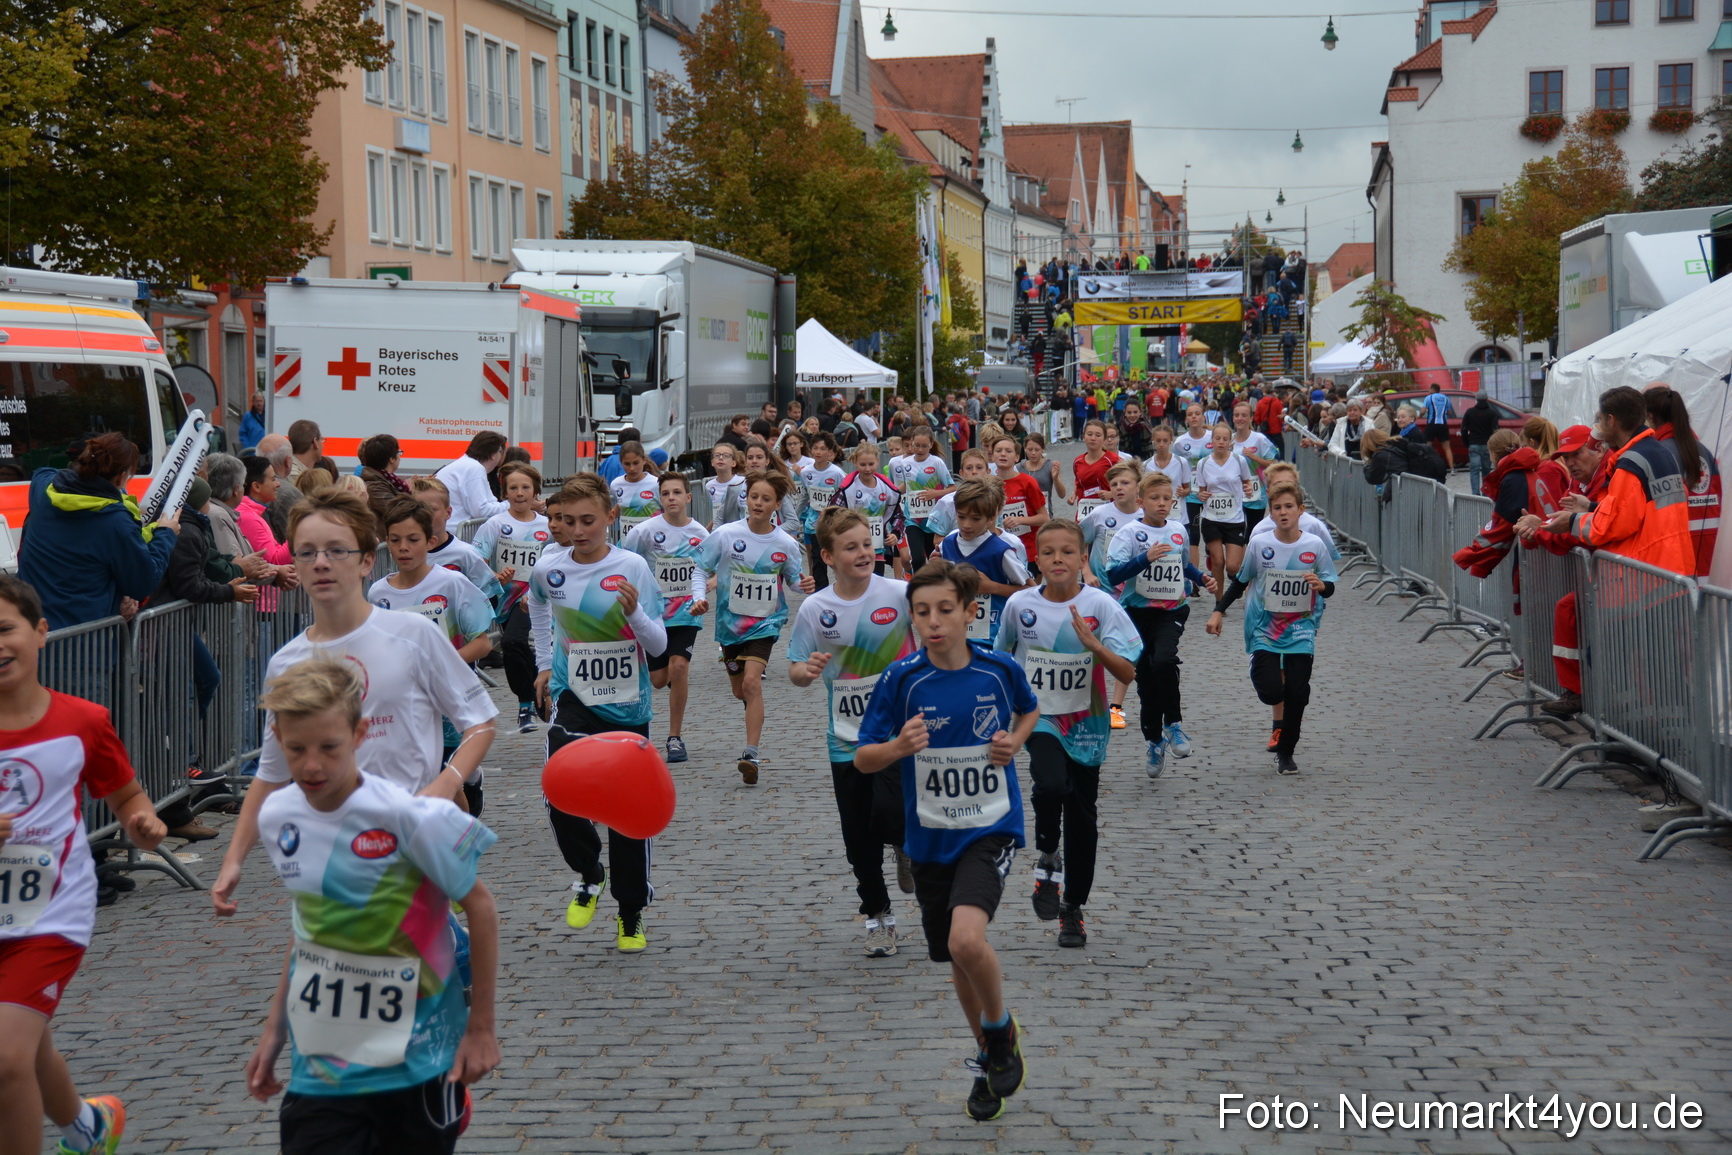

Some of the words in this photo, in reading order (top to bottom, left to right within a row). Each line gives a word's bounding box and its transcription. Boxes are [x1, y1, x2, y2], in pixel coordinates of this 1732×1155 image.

[1128, 305, 1186, 320] START
[477, 335, 505, 343] 44/54/1
[747, 315, 768, 354] BOCK
[378, 348, 459, 362] Bayerisches
[378, 364, 416, 376] Rotes
[801, 374, 853, 385] Laufsport
[377, 381, 417, 393] Kreuz
[418, 417, 503, 428] Katastrophenschutz
[426, 427, 463, 436] Freistaat
[1209, 500, 1233, 510] 4034
[500, 549, 537, 567] 4116
[660, 566, 695, 582] 4008
[1142, 565, 1181, 582] 4042
[734, 583, 773, 601] 4111
[1270, 580, 1309, 597] 4000
[873, 611, 895, 622] Hervis
[570, 648, 593, 656] PARTL
[593, 647, 627, 655] Neumarkt
[1027, 656, 1047, 665] PARTL
[575, 656, 633, 682] 4005
[1031, 667, 1087, 691] 4102
[591, 686, 616, 696] Louis
[834, 685, 850, 693] PARTL
[977, 709, 988, 722] FSV
[916, 754, 944, 764] PARTL
[946, 753, 990, 764] Neumarkt
[925, 764, 999, 798] 4006
[942, 804, 983, 819] Yannik
[25, 828, 53, 837] HERZ
[0, 869, 41, 904] 18
[299, 950, 331, 971] PARTL
[334, 962, 396, 979] Neumarkt
[300, 972, 404, 1023] 4113
